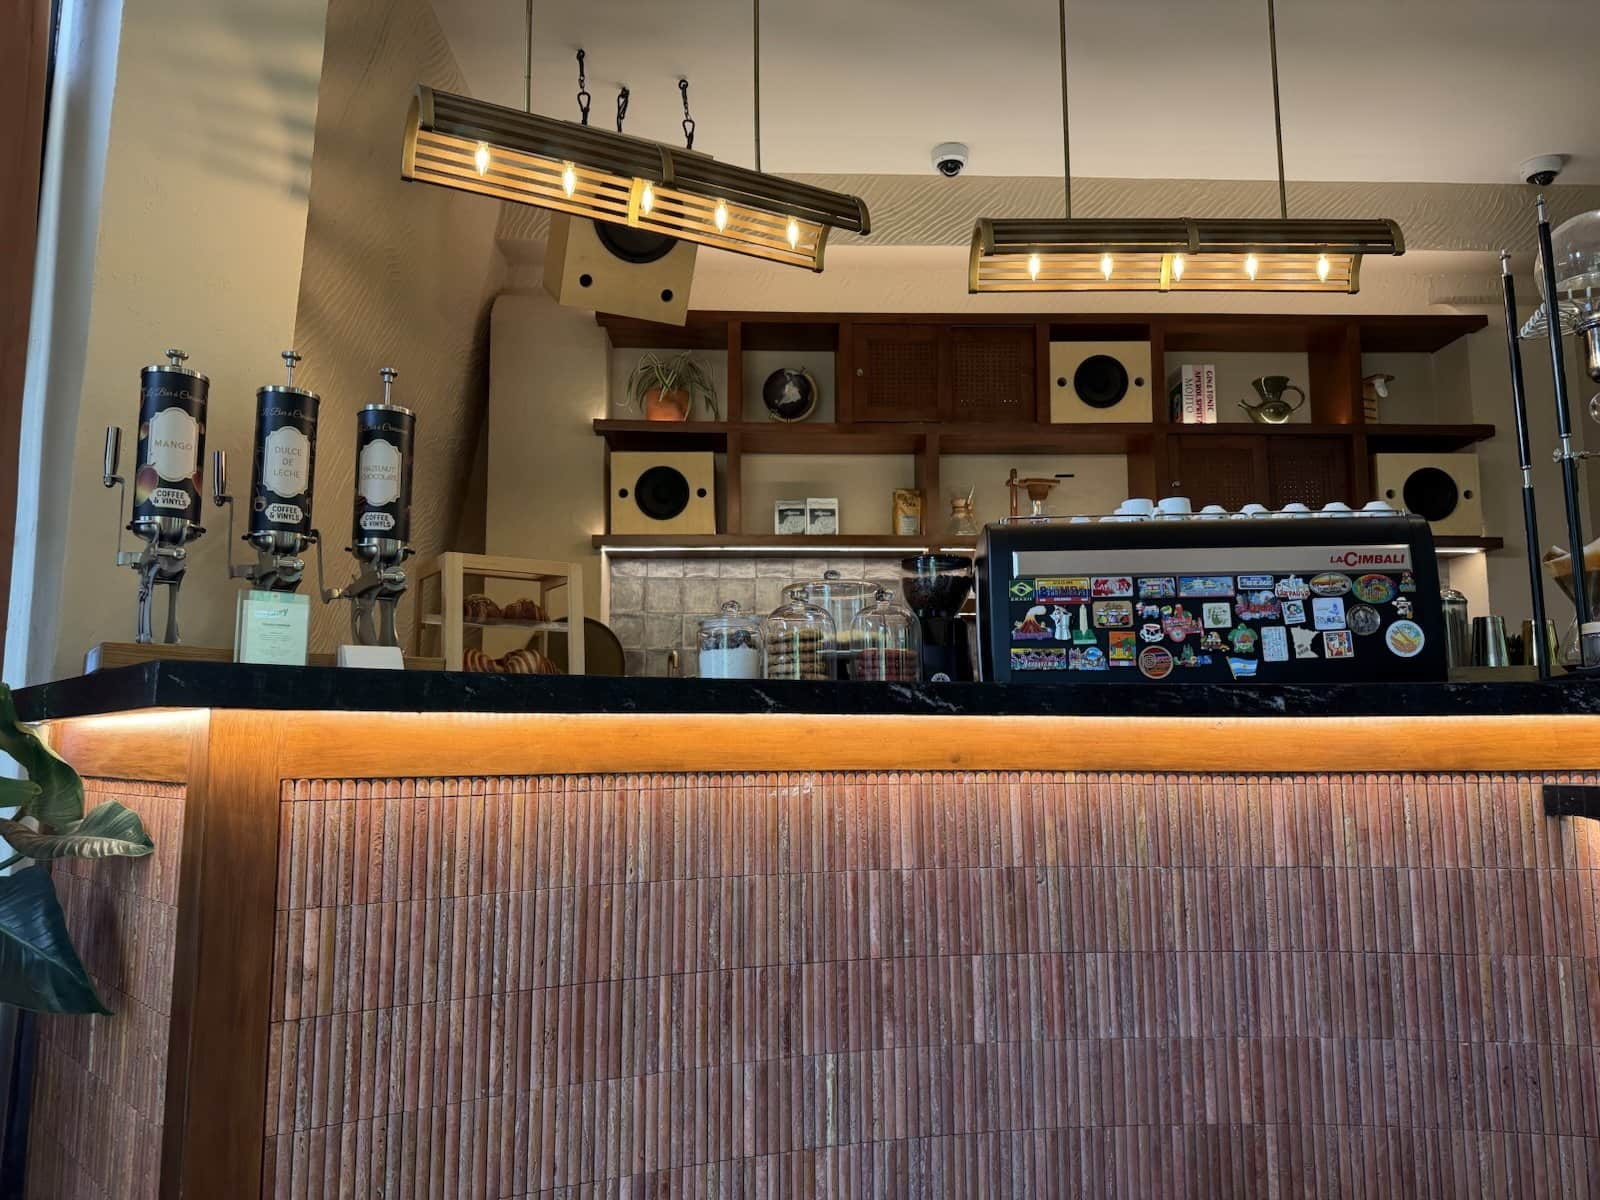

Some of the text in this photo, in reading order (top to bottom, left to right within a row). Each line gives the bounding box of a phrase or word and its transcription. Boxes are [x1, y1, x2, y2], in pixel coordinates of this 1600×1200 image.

[154, 439, 192, 450] MANGO
[274, 446, 302, 457] DULCE
[282, 457, 294, 466] DE
[273, 469, 300, 479] LECHE
[156, 490, 185, 500] COFFEE
[161, 497, 187, 506] VINYLS
[271, 504, 298, 514] COFFEE
[276, 512, 300, 521] VINYLS
[369, 520, 391, 528] VINYLS
